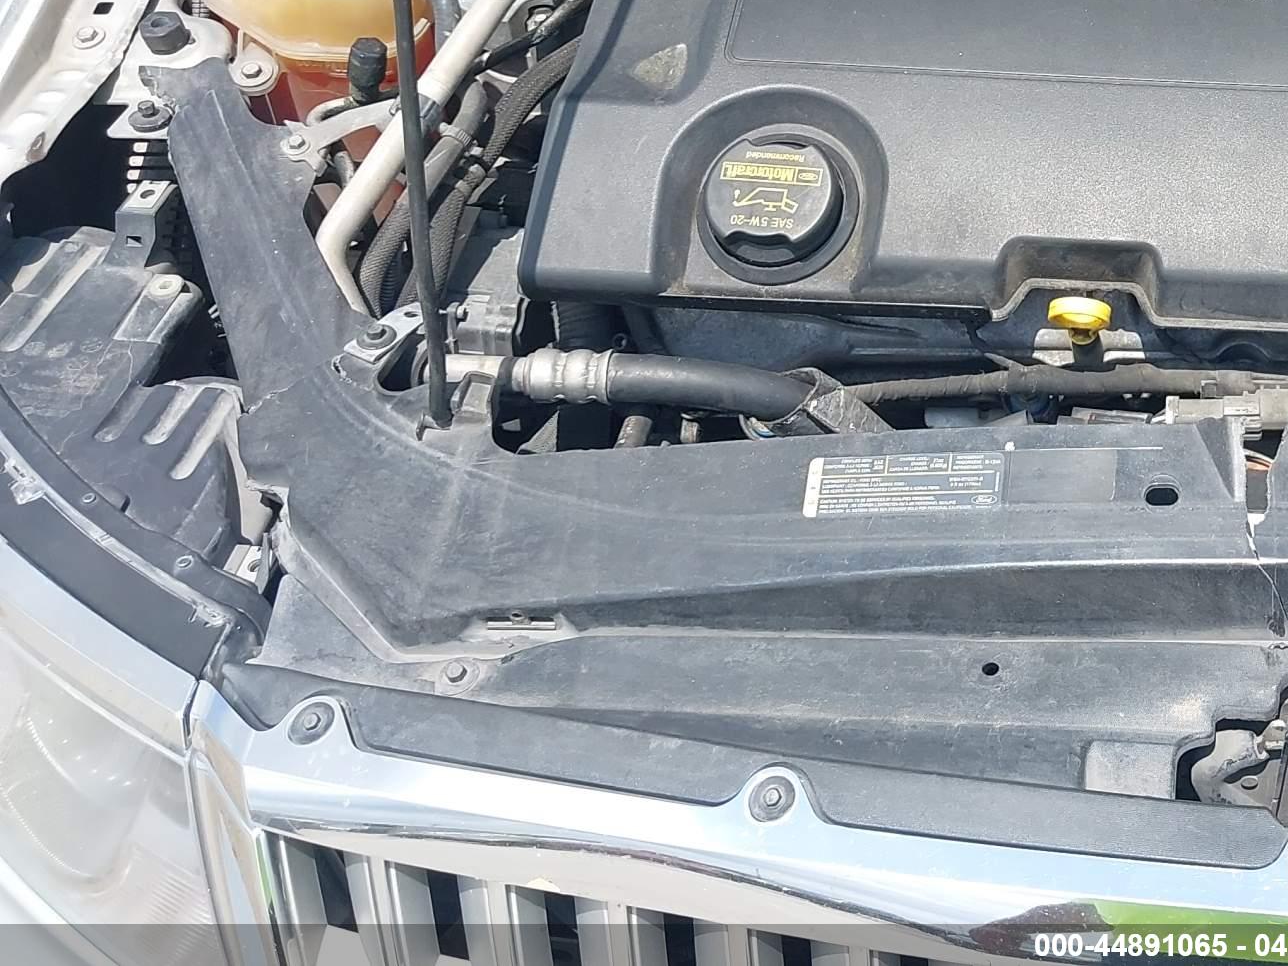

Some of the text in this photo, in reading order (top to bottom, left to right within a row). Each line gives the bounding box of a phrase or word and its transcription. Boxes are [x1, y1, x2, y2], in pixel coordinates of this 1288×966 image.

[746, 151, 805, 163] Recommended
[724, 164, 795, 180] Motorcraft
[730, 214, 794, 229] SAE 5W-20
